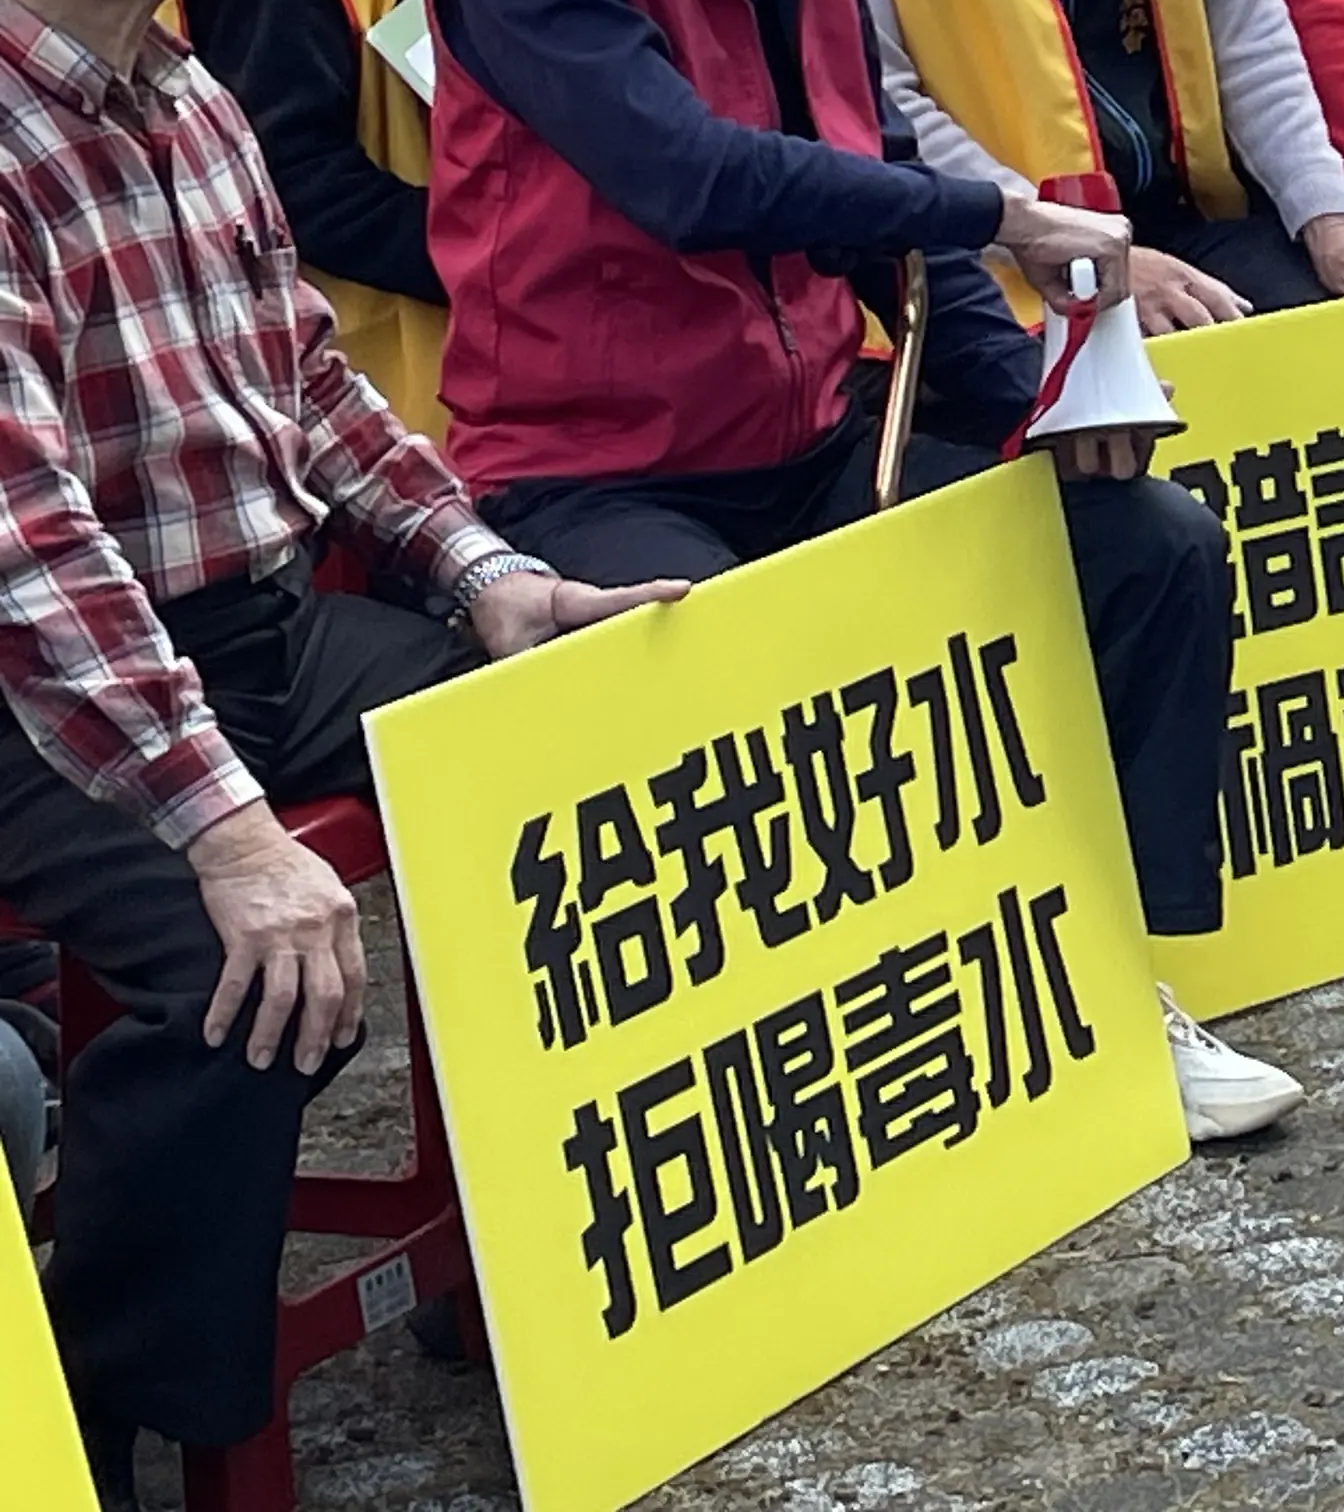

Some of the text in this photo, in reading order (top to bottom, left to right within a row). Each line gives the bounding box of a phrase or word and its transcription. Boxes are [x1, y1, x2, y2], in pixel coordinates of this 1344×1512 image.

[510, 631, 1047, 1051] 給我好水
[562, 884, 1095, 1340] 拒喝毒水
